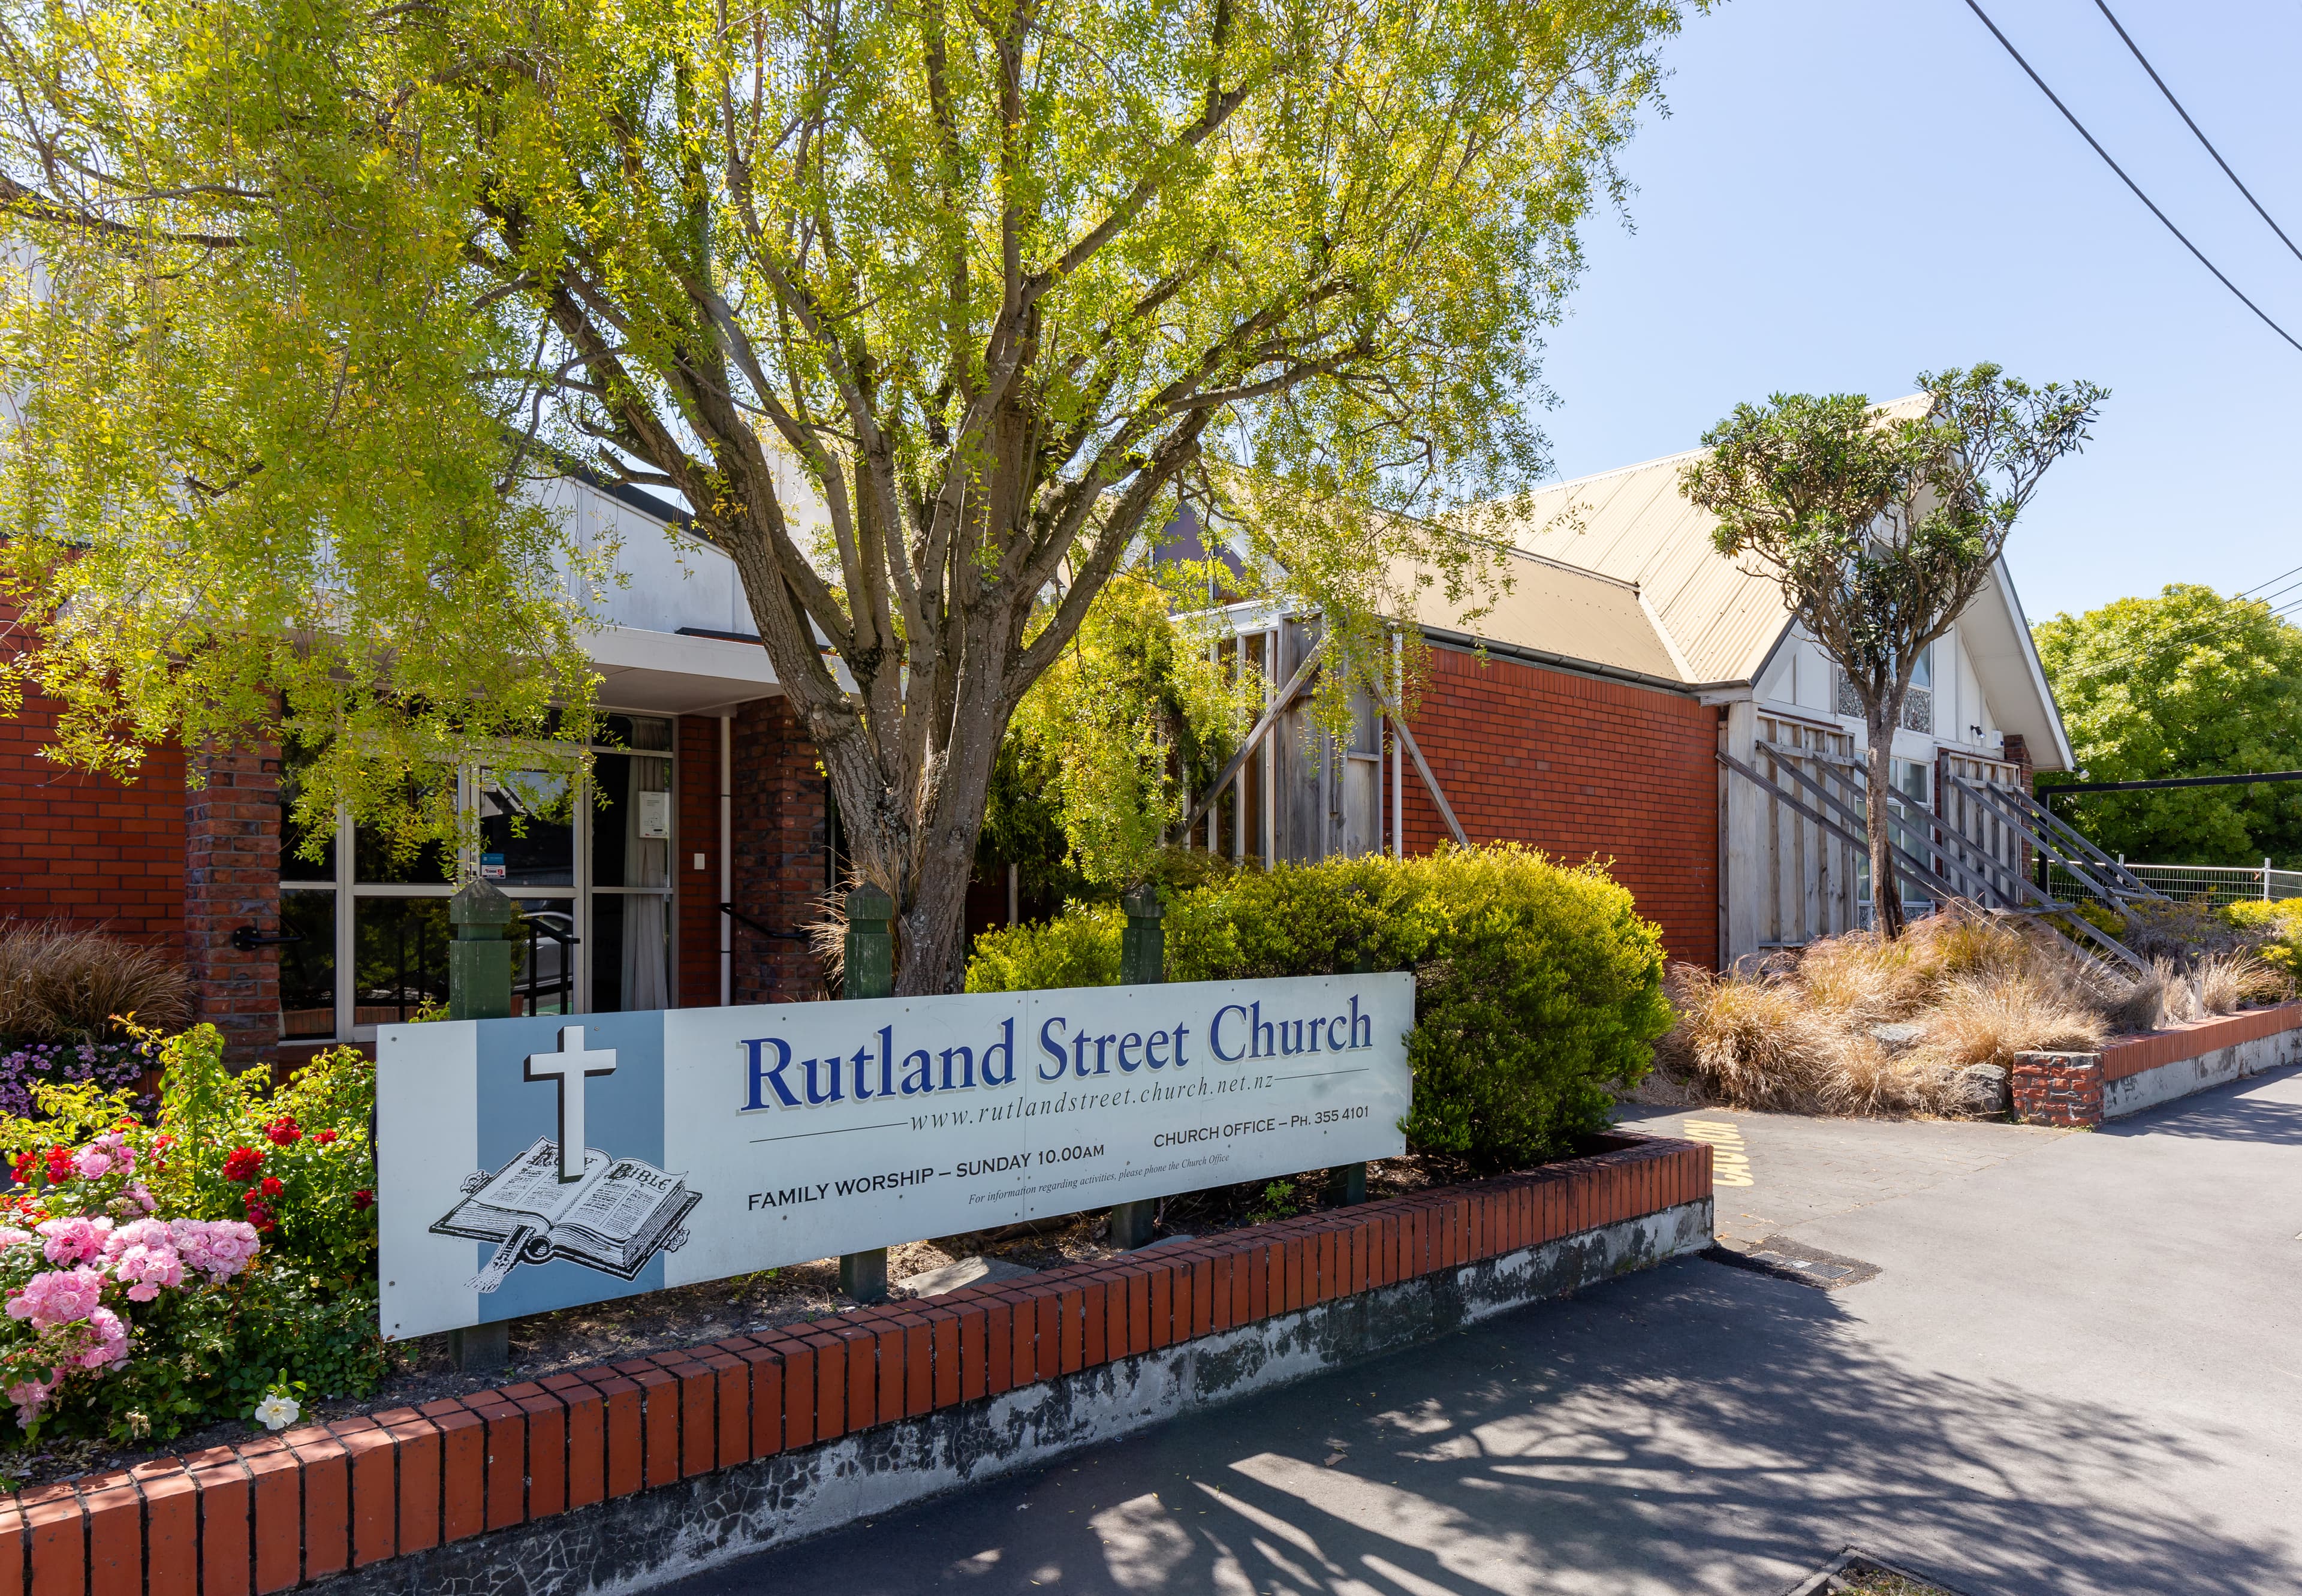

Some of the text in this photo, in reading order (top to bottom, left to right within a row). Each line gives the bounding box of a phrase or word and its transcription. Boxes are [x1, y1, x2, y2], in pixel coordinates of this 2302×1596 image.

[738, 993, 1373, 1115] Rutland Street Church
[911, 1075, 1273, 1131] www.rutlandstreet.church.net.nz
[1153, 1126, 1219, 1148] CHURCH
[1223, 1118, 1275, 1137] OFFICE
[1315, 1109, 1339, 1124] 355
[1342, 1106, 1369, 1120] 4101
[604, 1163, 672, 1191] BIBLE
[748, 1183, 830, 1211] FAMILY
[834, 1167, 934, 1197] WORSHIP
[956, 1152, 1032, 1178] SUNDAY
[1038, 1145, 1105, 1165] 10.00AM
[969, 1154, 1230, 1204] For information regarding activities, please phone the Church Office
